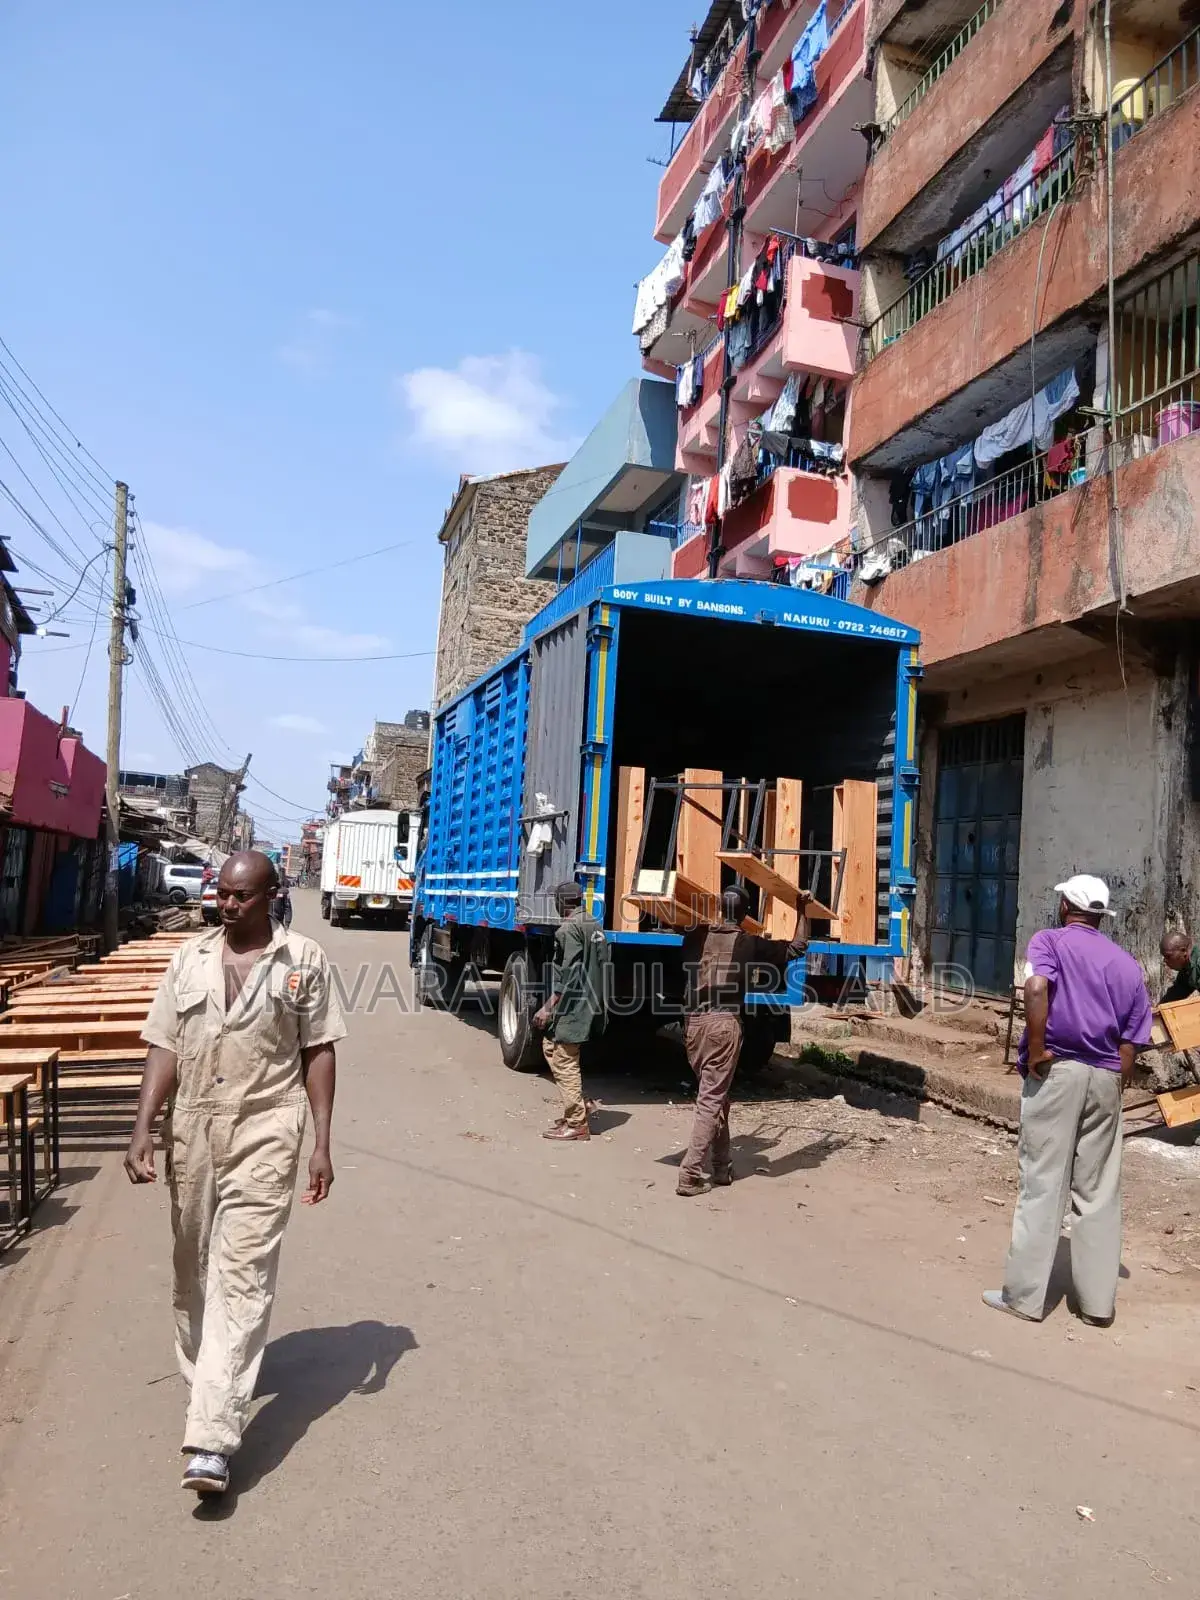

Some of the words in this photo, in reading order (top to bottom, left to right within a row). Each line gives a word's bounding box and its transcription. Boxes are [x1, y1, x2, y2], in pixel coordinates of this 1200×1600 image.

[613, 589, 639, 601] BODY
[644, 593, 673, 606] BUILT
[678, 598, 693, 608] BY
[783, 612, 830, 627] NAKURU
